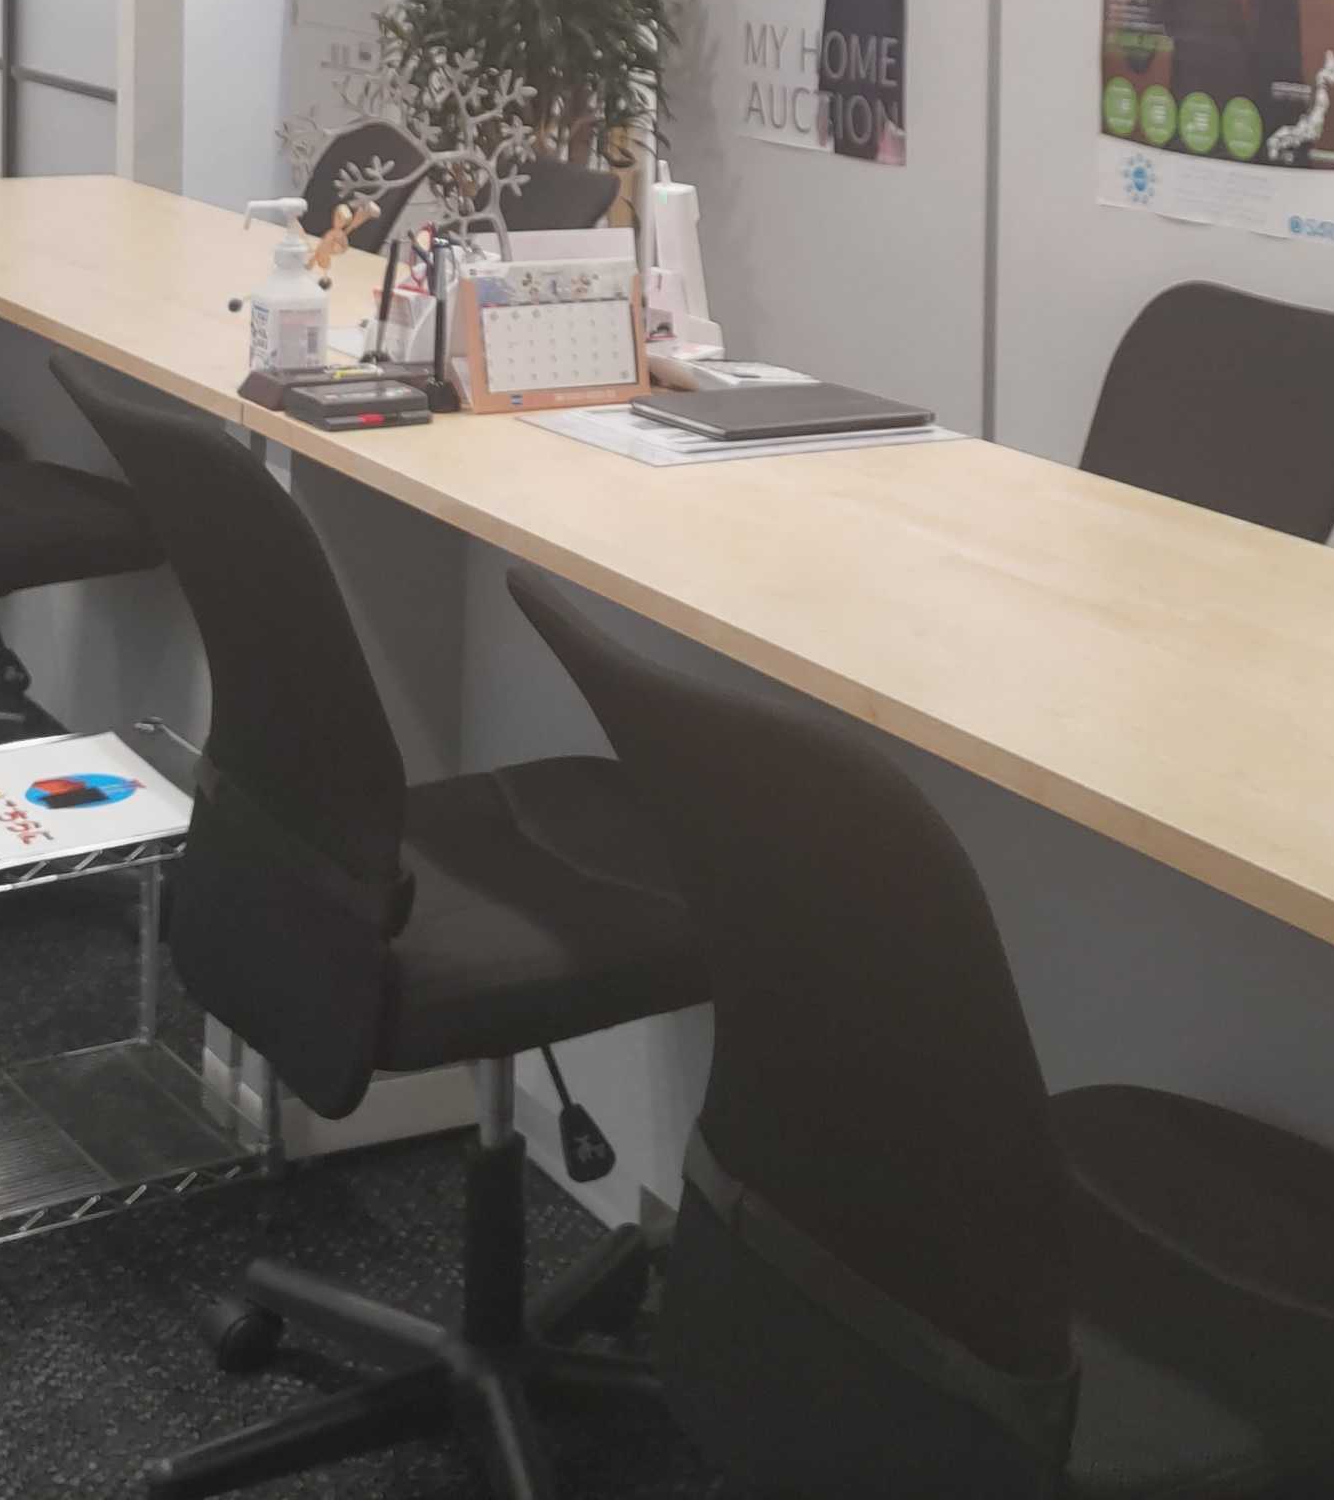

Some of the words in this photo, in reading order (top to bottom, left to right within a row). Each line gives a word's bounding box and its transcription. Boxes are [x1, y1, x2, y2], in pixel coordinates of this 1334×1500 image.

[744, 21, 789, 69] MY
[801, 28, 899, 87] HOME
[744, 81, 900, 147] AUCTION
